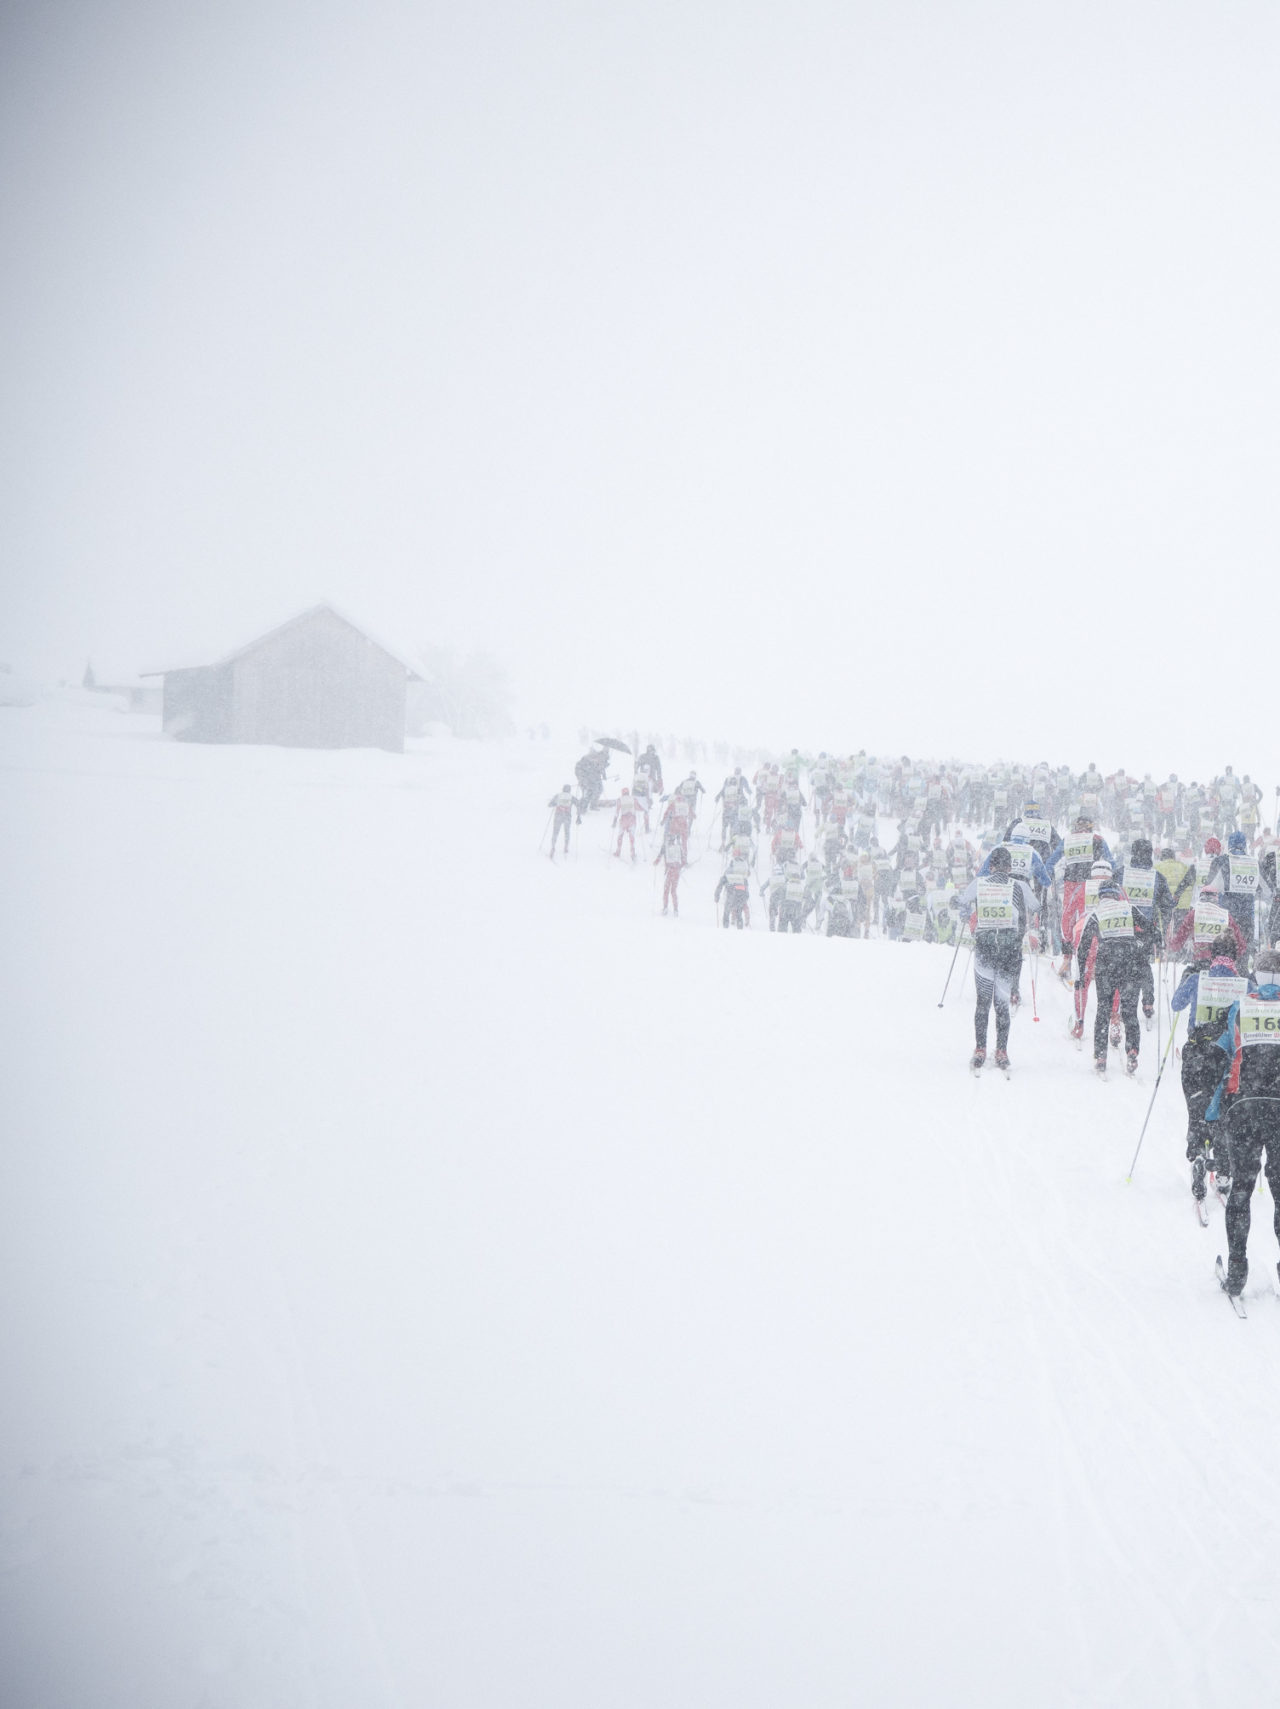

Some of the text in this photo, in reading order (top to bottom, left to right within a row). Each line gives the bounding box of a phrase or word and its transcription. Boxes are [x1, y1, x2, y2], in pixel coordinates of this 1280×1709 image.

[1029, 826, 1047, 835] 946
[1012, 858, 1026, 868] 55
[1236, 874, 1255, 885] 949
[1128, 888, 1148, 898] 724
[982, 906, 1006, 918] 653
[1105, 917, 1127, 928] 727
[1200, 923, 1222, 934] 729
